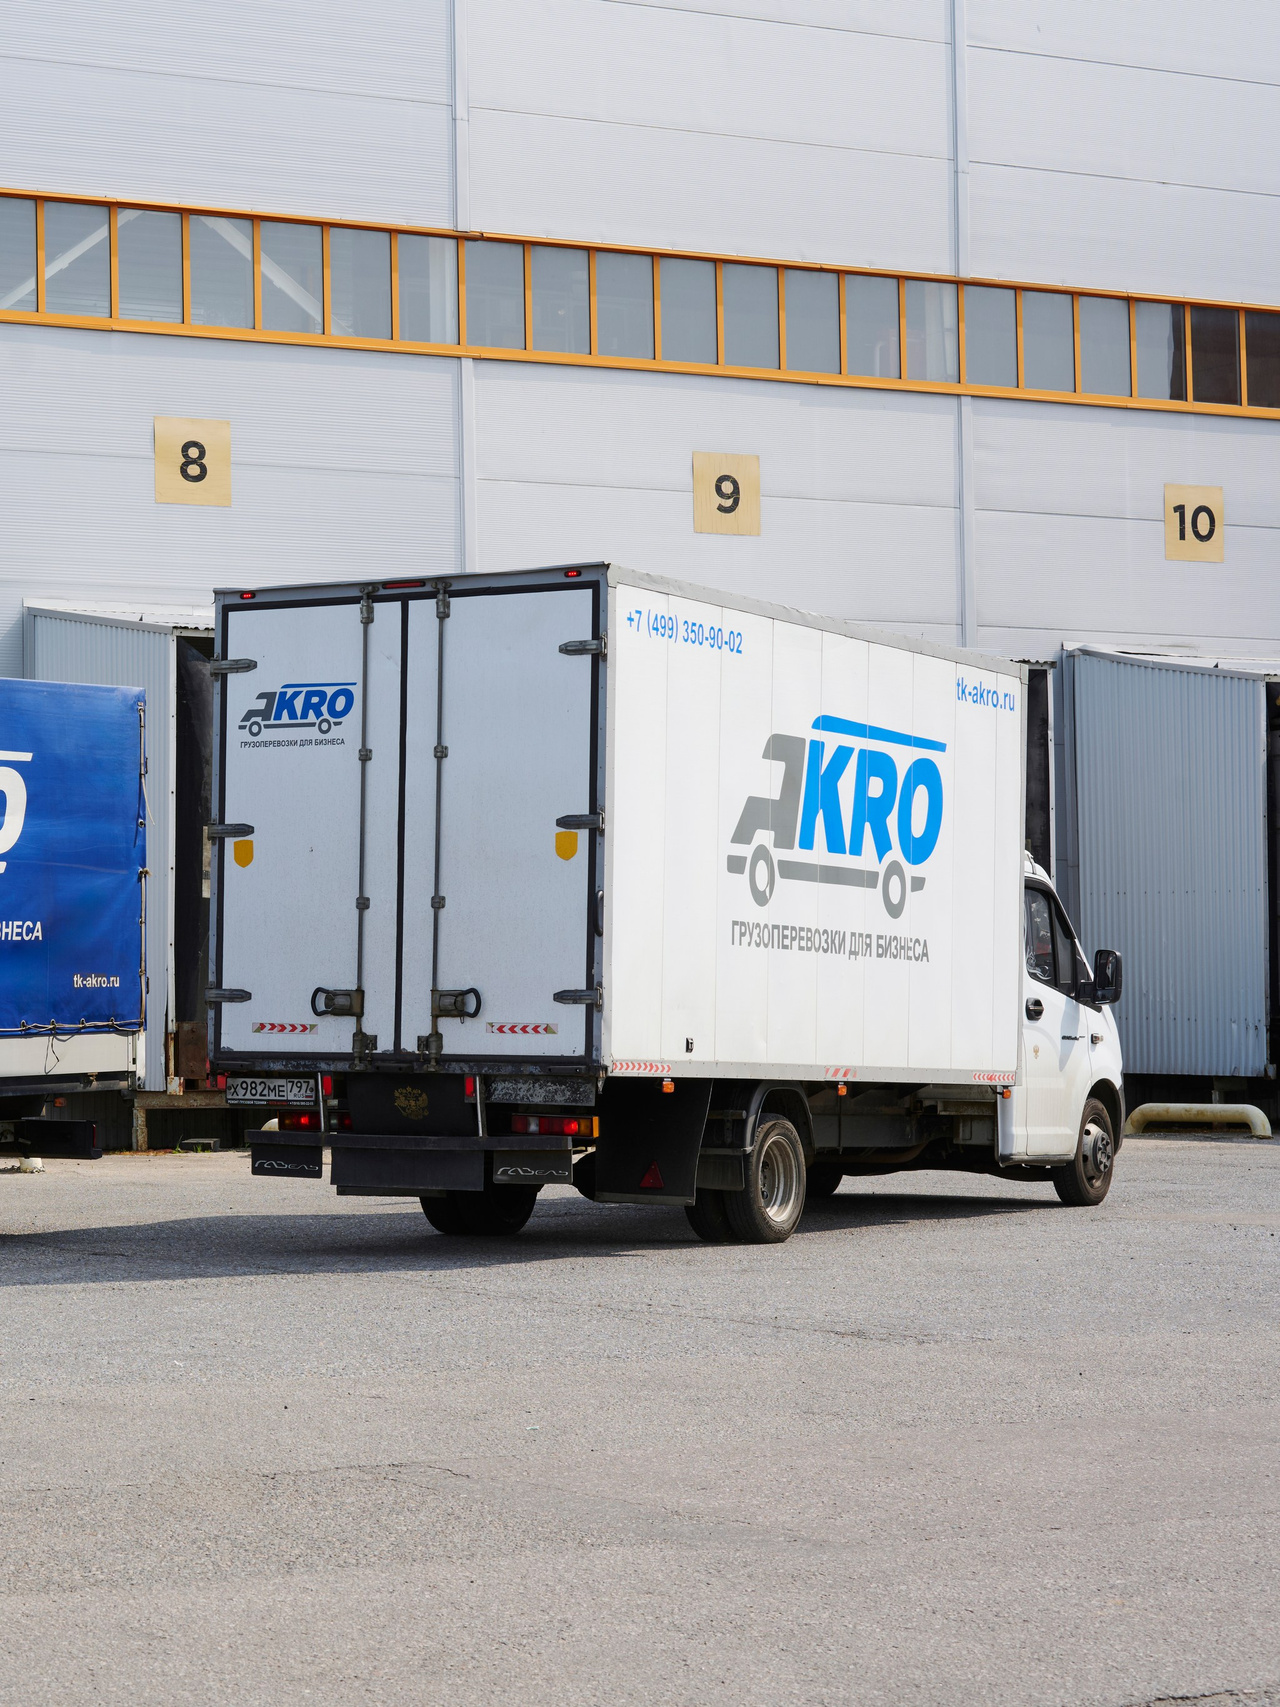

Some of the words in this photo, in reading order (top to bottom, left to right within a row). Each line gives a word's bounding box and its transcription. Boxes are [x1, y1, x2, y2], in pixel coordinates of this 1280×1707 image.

[180, 441, 208, 483] 8
[715, 474, 741, 514] 9
[1173, 504, 1216, 543] 10
[626, 609, 642, 632] +7
[647, 609, 678, 643] (499)
[682, 620, 743, 654] 350-90-02
[956, 677, 1015, 711] tk-akro.ru
[240, 739, 298, 749] ГРУЗОПЕРЕВОЗКИ
[299, 738, 313, 747] ДЛЯ
[314, 738, 346, 747] БИЗНЕСА
[731, 920, 846, 956] ГРУЗОПЕРЕВОЗКИ
[848, 931, 872, 961] ДЛЯ
[876, 934, 930, 963] БИЗНЕСА
[73, 973, 120, 988] tk-akro.ru
[288, 1080, 310, 1094] 797
